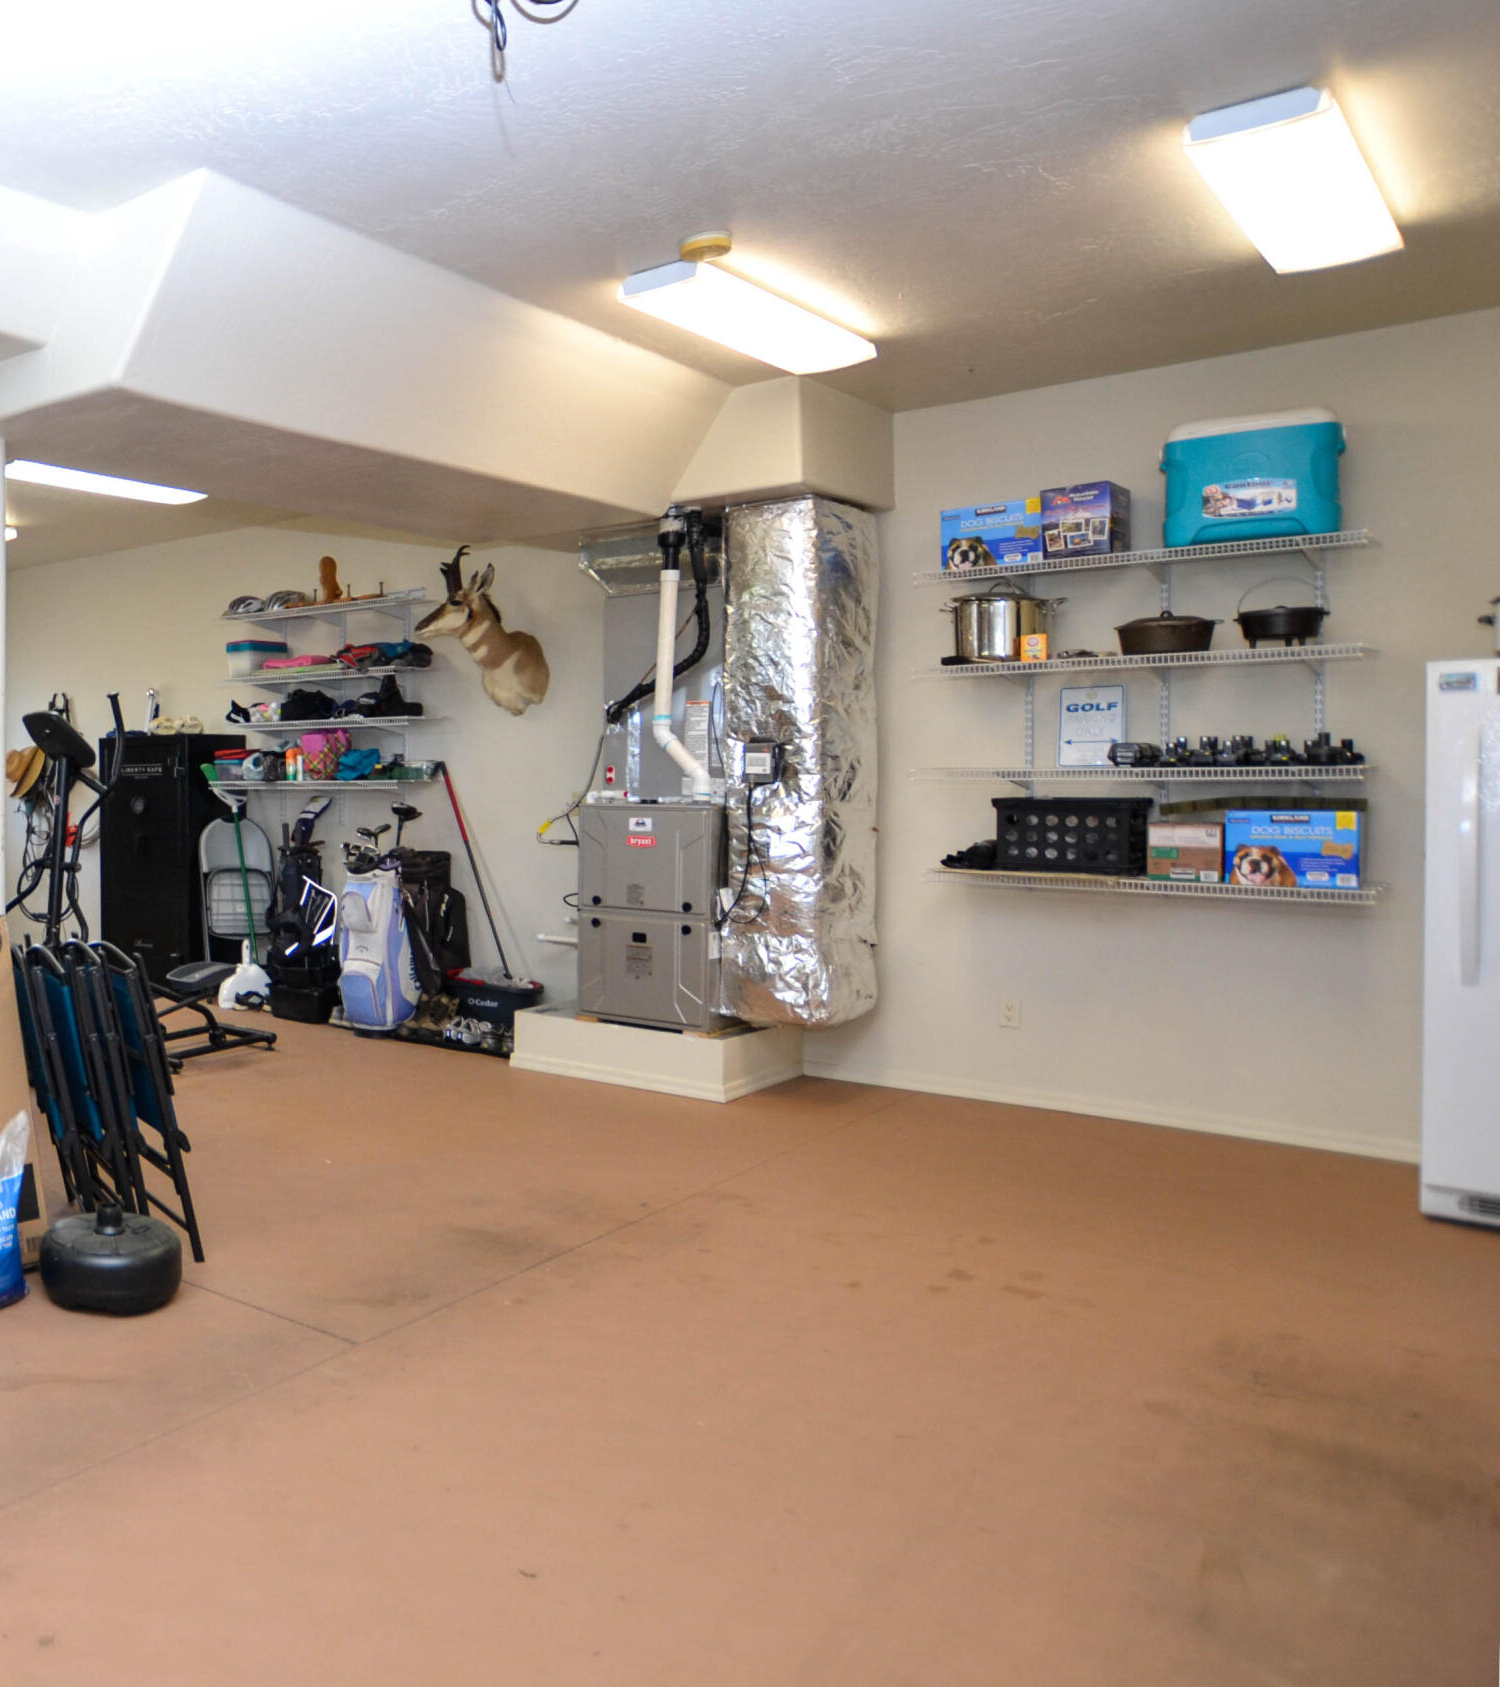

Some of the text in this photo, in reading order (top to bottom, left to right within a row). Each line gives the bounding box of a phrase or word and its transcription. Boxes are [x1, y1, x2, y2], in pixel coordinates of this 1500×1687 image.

[960, 513, 1024, 528] DOG BISCUITS
[1065, 701, 1118, 713] GOLF
[1251, 825, 1333, 835] DOG BISCUITS
[468, 997, 499, 1008] O-Cedar
